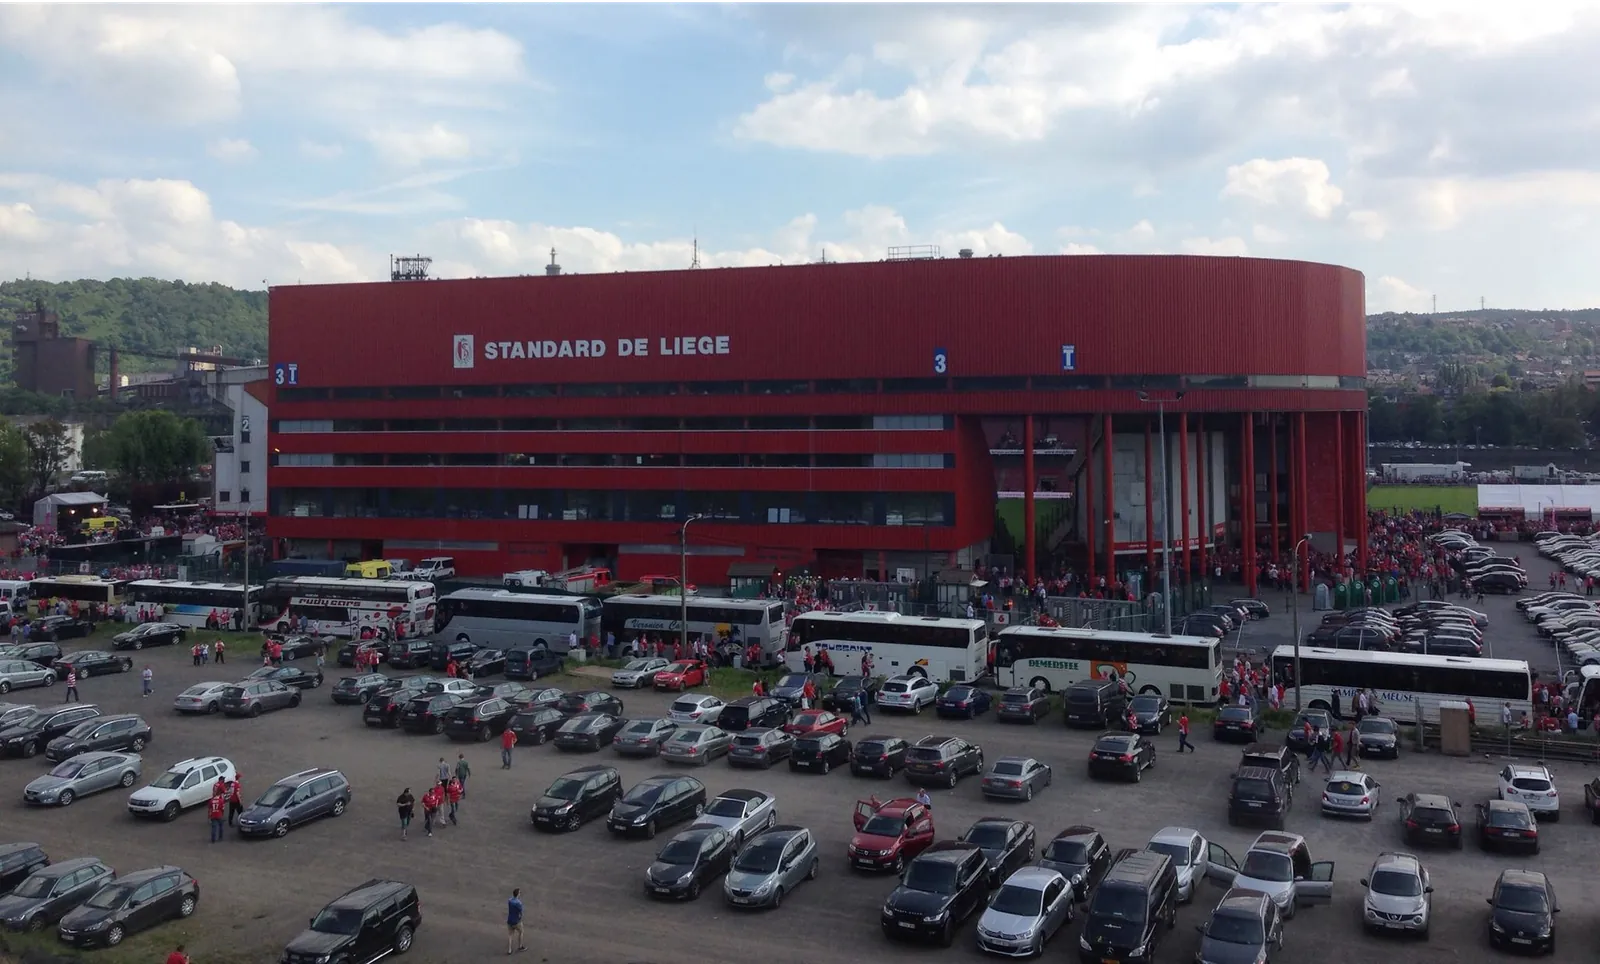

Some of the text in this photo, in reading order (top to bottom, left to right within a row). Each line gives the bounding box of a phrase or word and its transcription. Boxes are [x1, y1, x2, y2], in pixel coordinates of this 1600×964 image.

[484, 336, 730, 360] STANDARD DE LIEGE
[934, 354, 946, 373] 3
[276, 368, 284, 385] 3
[242, 419, 249, 432] 2
[668, 620, 688, 630] Cas
[1381, 692, 1413, 702] MEUSE
